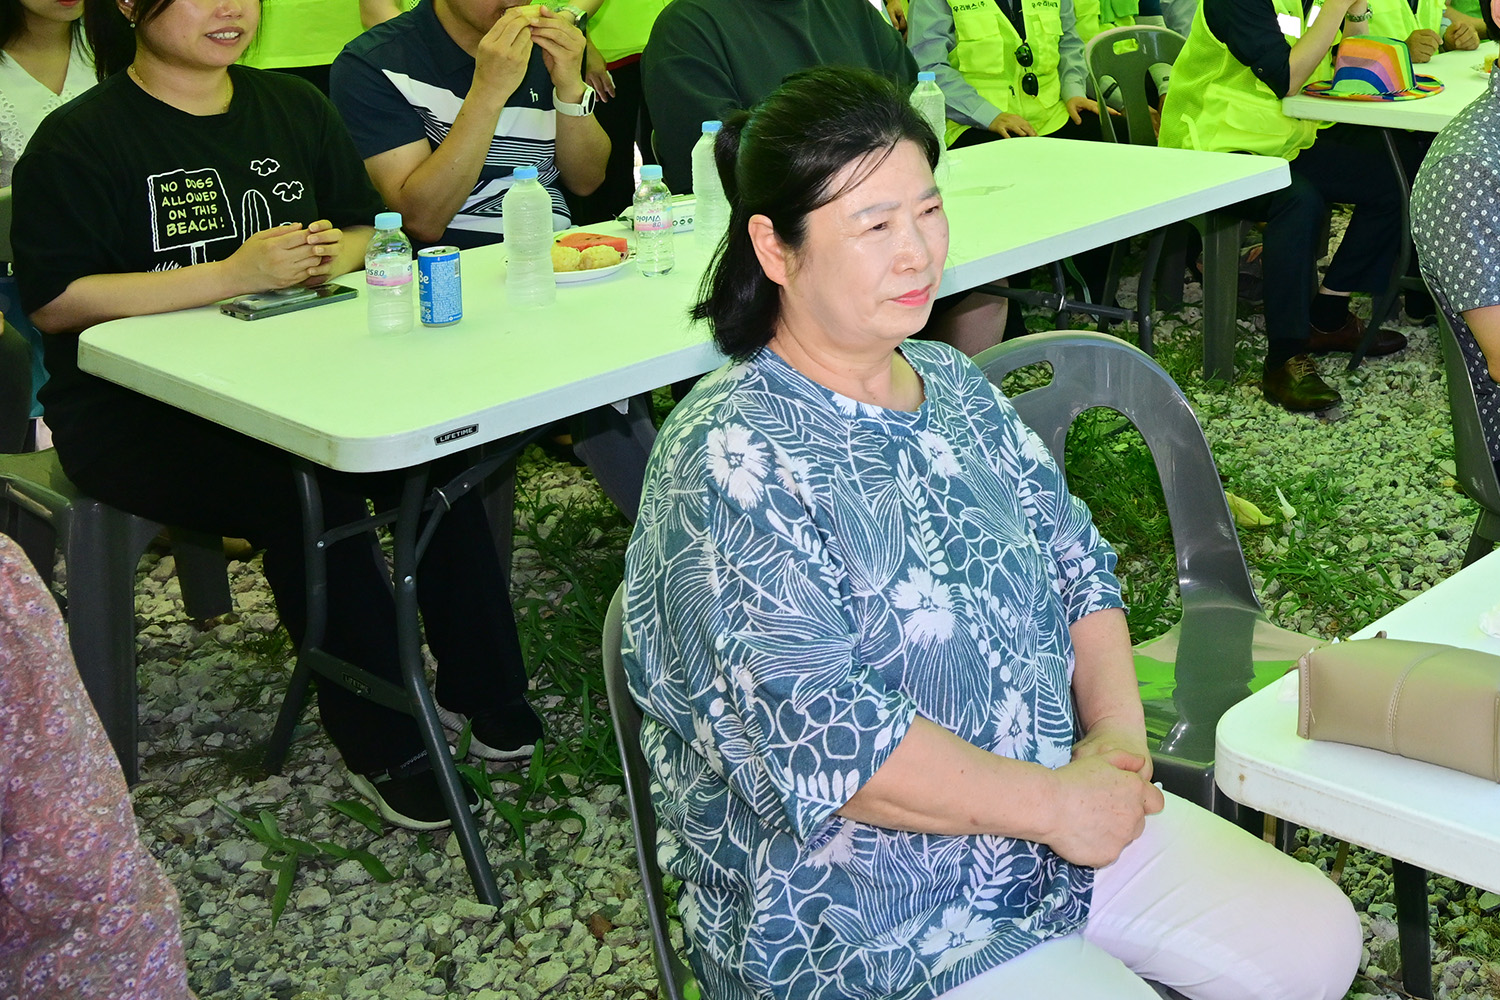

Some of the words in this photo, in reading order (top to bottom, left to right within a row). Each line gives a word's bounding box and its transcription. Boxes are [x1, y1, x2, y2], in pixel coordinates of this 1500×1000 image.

[160, 181, 178, 193] NO
[185, 177, 214, 189] DOGS
[161, 191, 218, 207] ALLOWED
[168, 208, 187, 221] ON
[191, 203, 218, 216] THIS
[439, 427, 473, 442] LIFETIME
